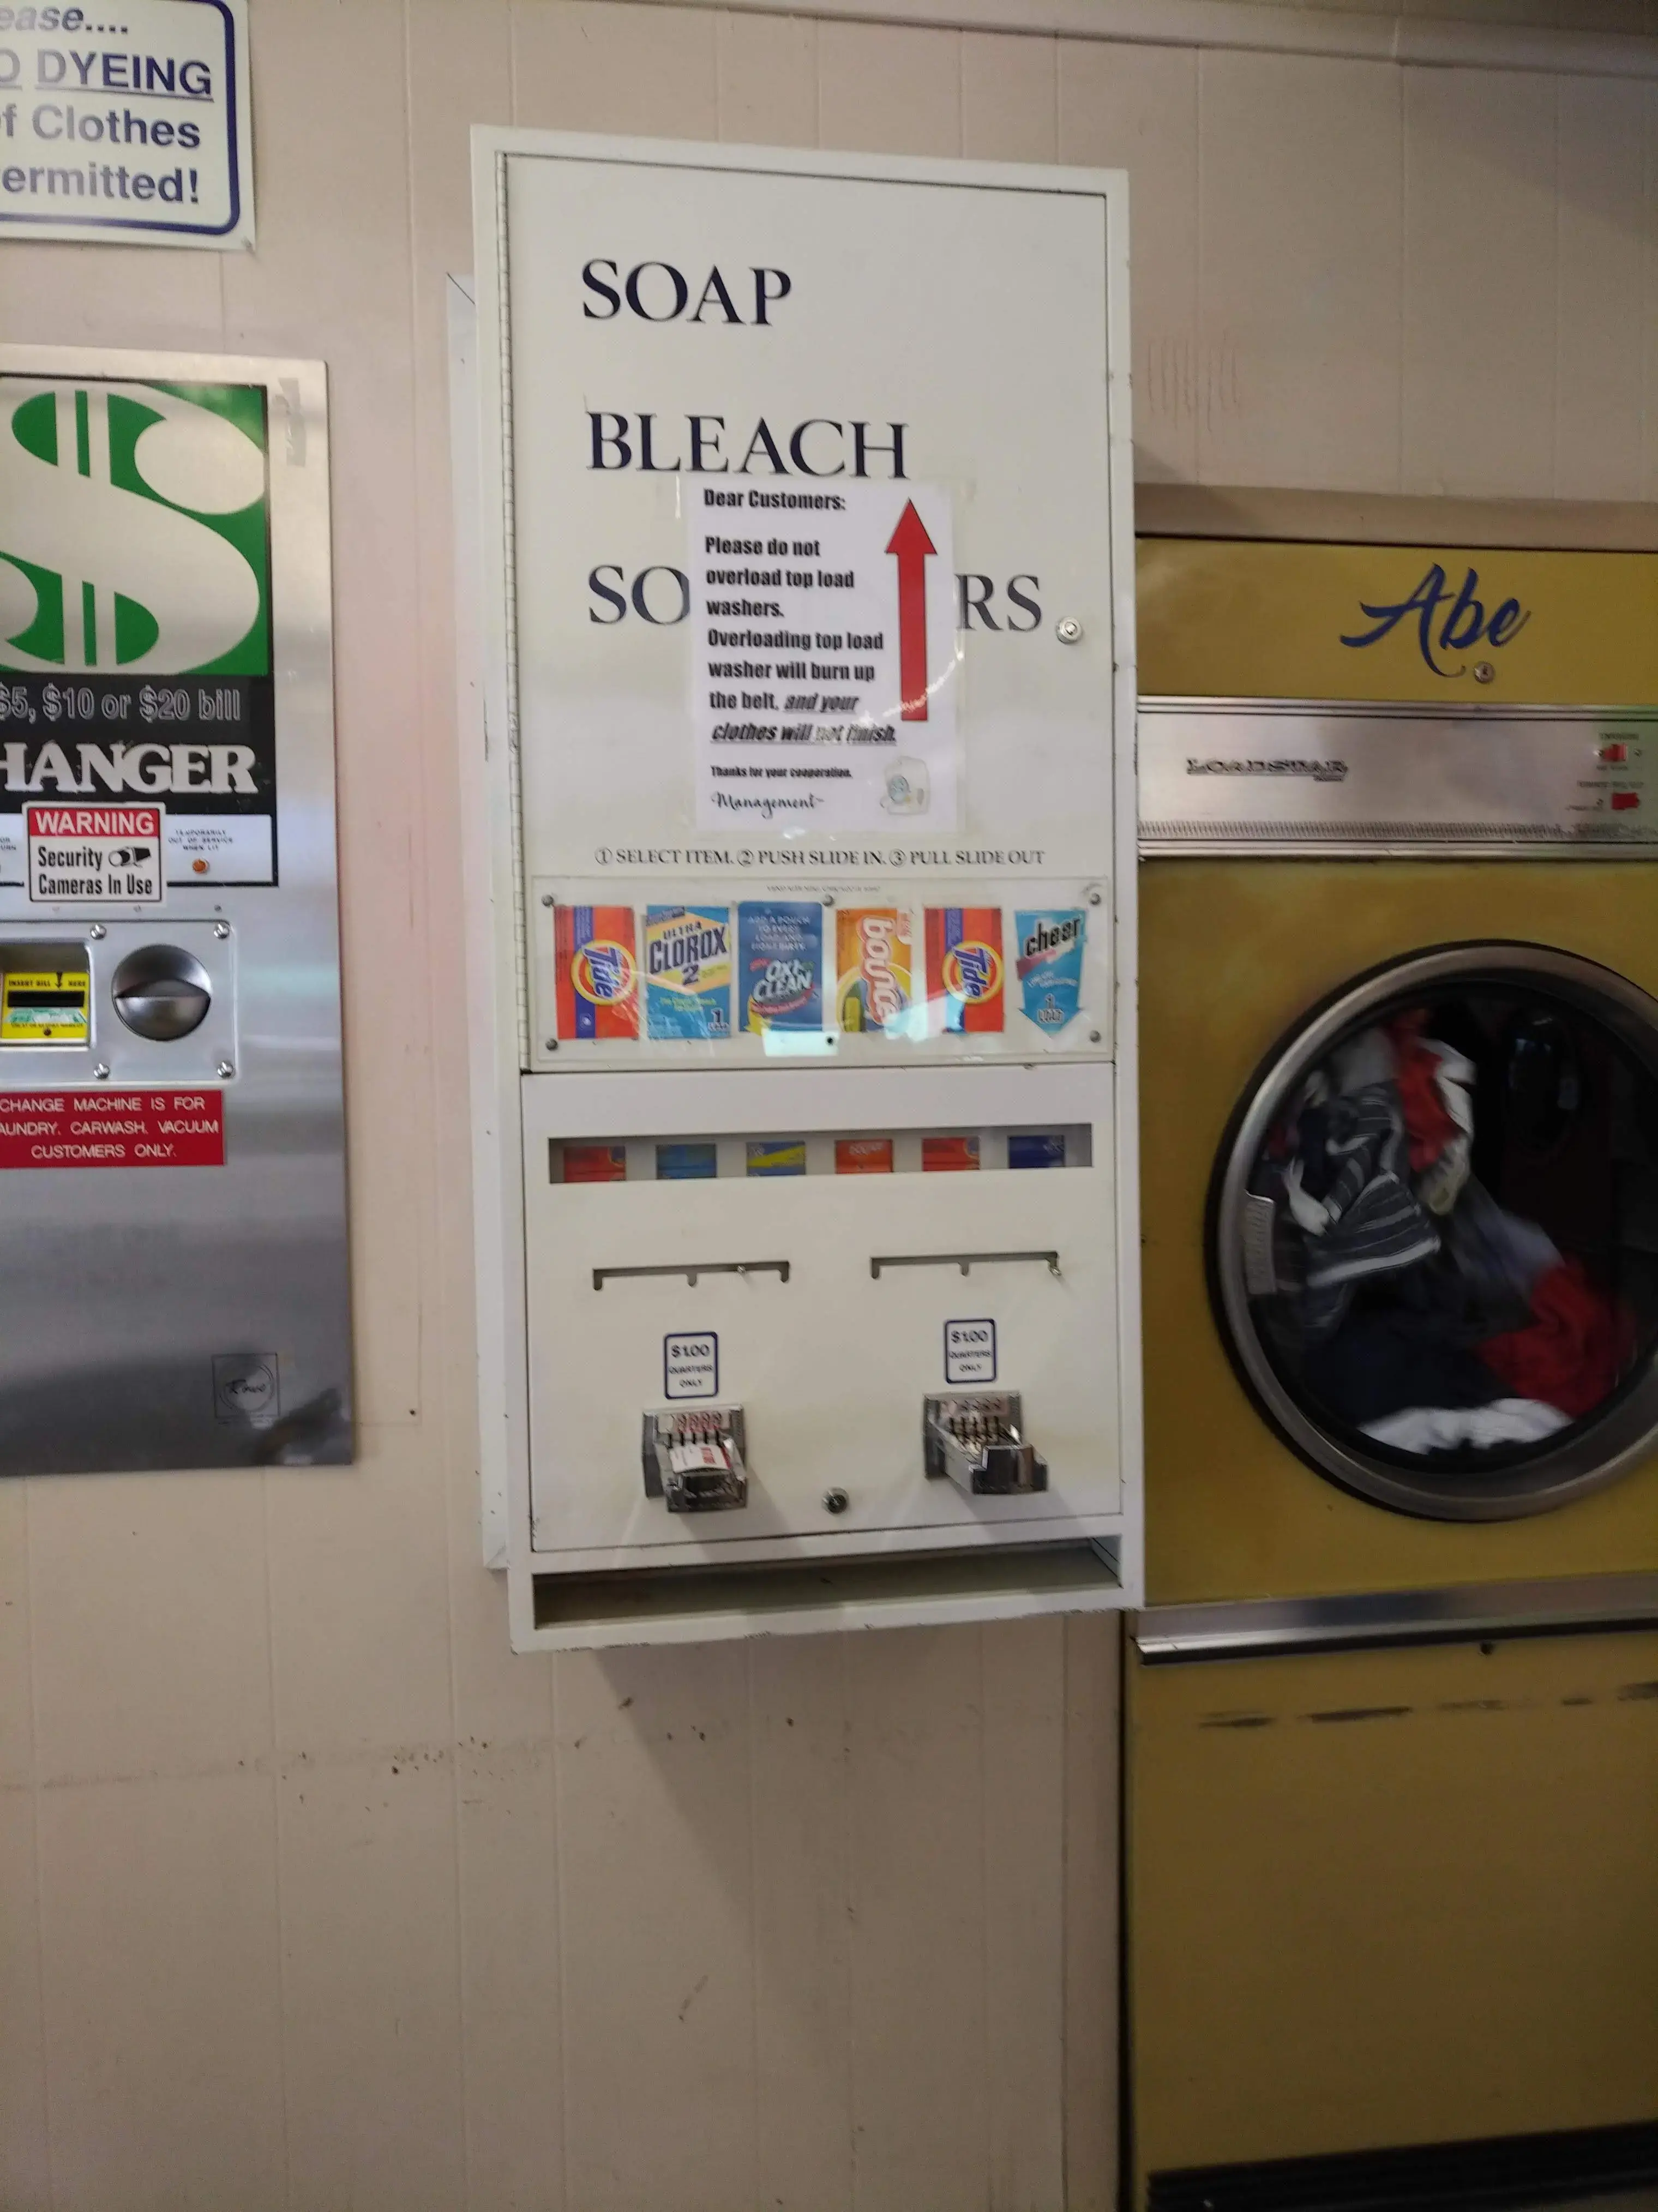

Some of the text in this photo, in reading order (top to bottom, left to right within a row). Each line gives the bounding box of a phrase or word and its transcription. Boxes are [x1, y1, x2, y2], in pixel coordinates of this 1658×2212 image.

[0, 7, 128, 34] ease....
[0, 48, 212, 95] O DYEING
[32, 104, 201, 148] Clothes
[2, 161, 199, 203] ermitted!
[581, 259, 792, 326] SOAP
[585, 411, 911, 479] BLEACH
[704, 488, 846, 512] Dear Customers:
[705, 536, 820, 557] Please do not
[706, 568, 855, 588] overload top load
[706, 598, 784, 617] washers.
[1339, 562, 1531, 678] Abe
[707, 628, 884, 651] Overloading top load
[708, 661, 874, 682] washer will burn up
[43, 682, 94, 722] $10
[101, 693, 131, 720] or
[139, 684, 190, 723] $20
[198, 688, 241, 721] bill
[709, 691, 737, 709] the
[784, 693, 817, 712] and
[820, 695, 860, 713] your
[711, 722, 778, 741] clothes
[780, 723, 814, 742] will
[0, 738, 259, 794] HANGER
[710, 765, 747, 777] Thanks
[749, 765, 762, 777] for
[765, 766, 787, 779] your
[35, 812, 154, 835] WARNING
[38, 846, 103, 871] Security
[616, 848, 681, 864] SELECT
[758, 849, 804, 865] PUSH
[808, 850, 860, 865] SLIDE
[909, 850, 952, 865] PULL
[955, 849, 1006, 865] SLIDE
[1007, 849, 1046, 865] OUT
[38, 873, 153, 895] Cameras In Use
[1025, 917, 1080, 956] cheer
[580, 945, 621, 1000] Tide
[682, 964, 699, 987] 2
[952, 946, 990, 998] Tide
[0, 1096, 206, 1113] CHANGE MACHINE IS FOR
[157, 1119, 219, 1134] VACUUM
[31, 1143, 126, 1159] CUSTOMERS
